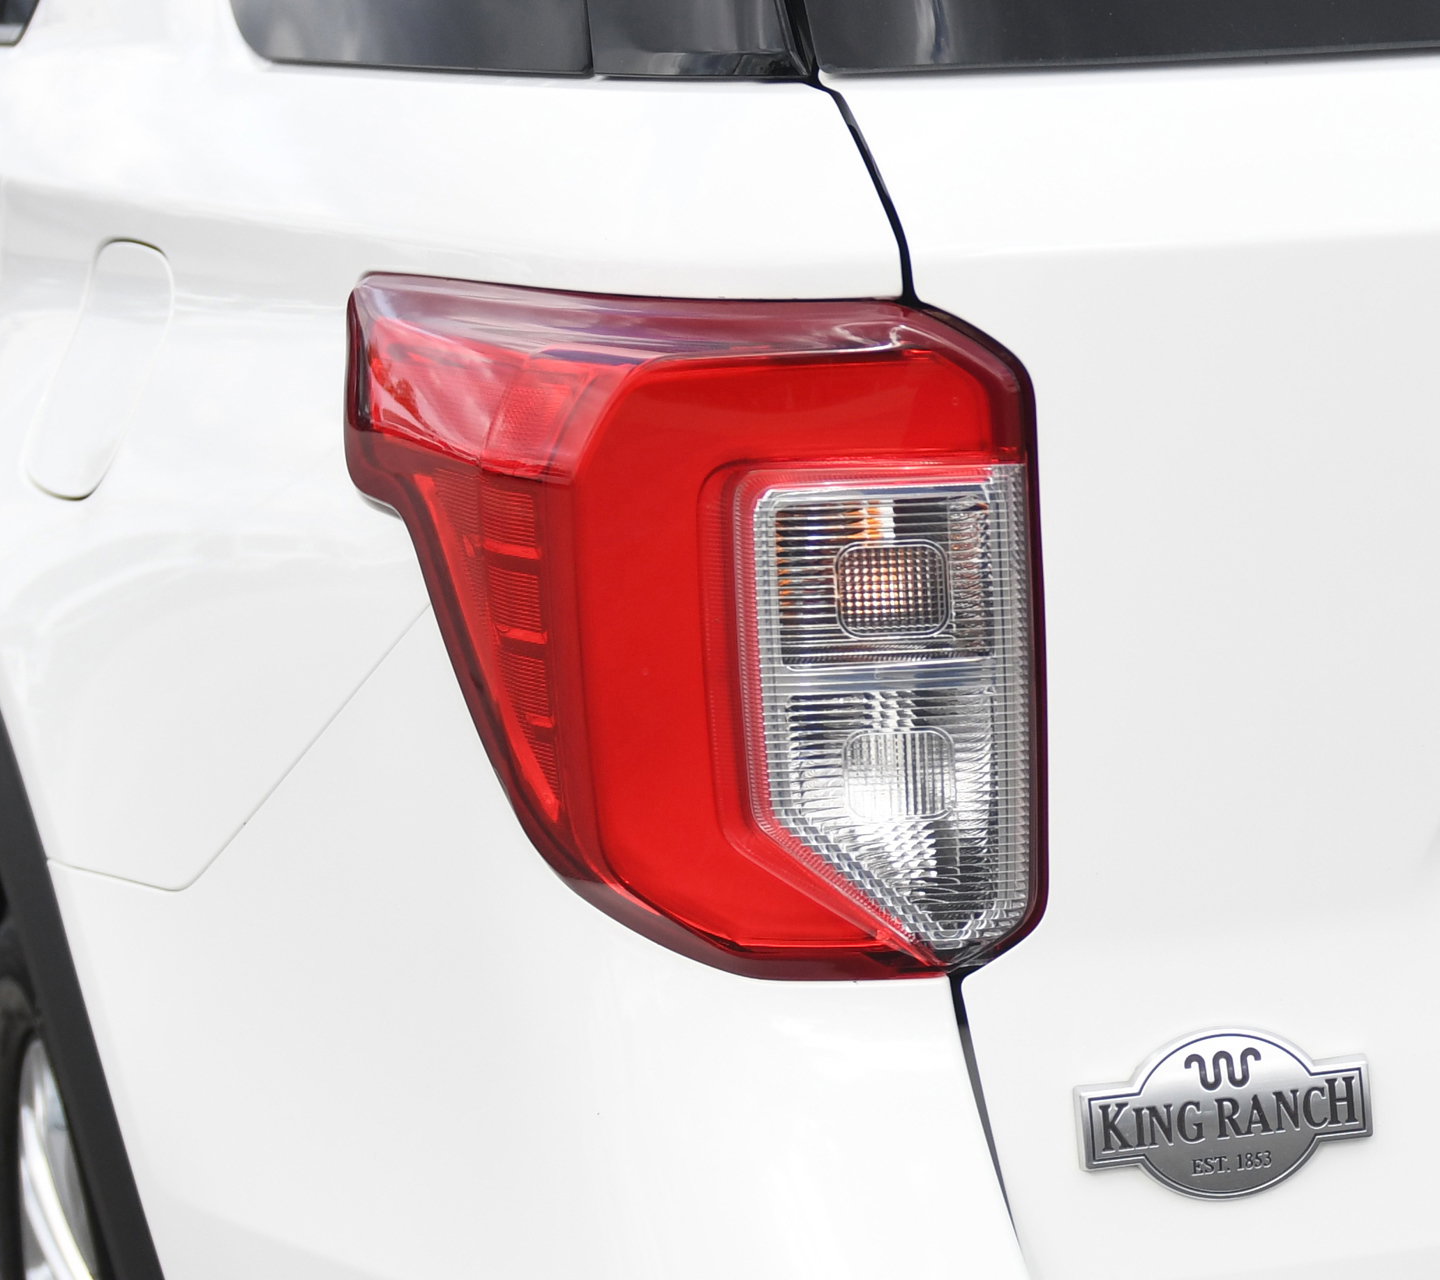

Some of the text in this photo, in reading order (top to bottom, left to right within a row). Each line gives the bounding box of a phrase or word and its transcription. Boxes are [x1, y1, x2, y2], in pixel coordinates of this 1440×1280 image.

[1097, 1075, 1360, 1154] KING RANCH
[1190, 1150, 1273, 1176] EST. 1853
